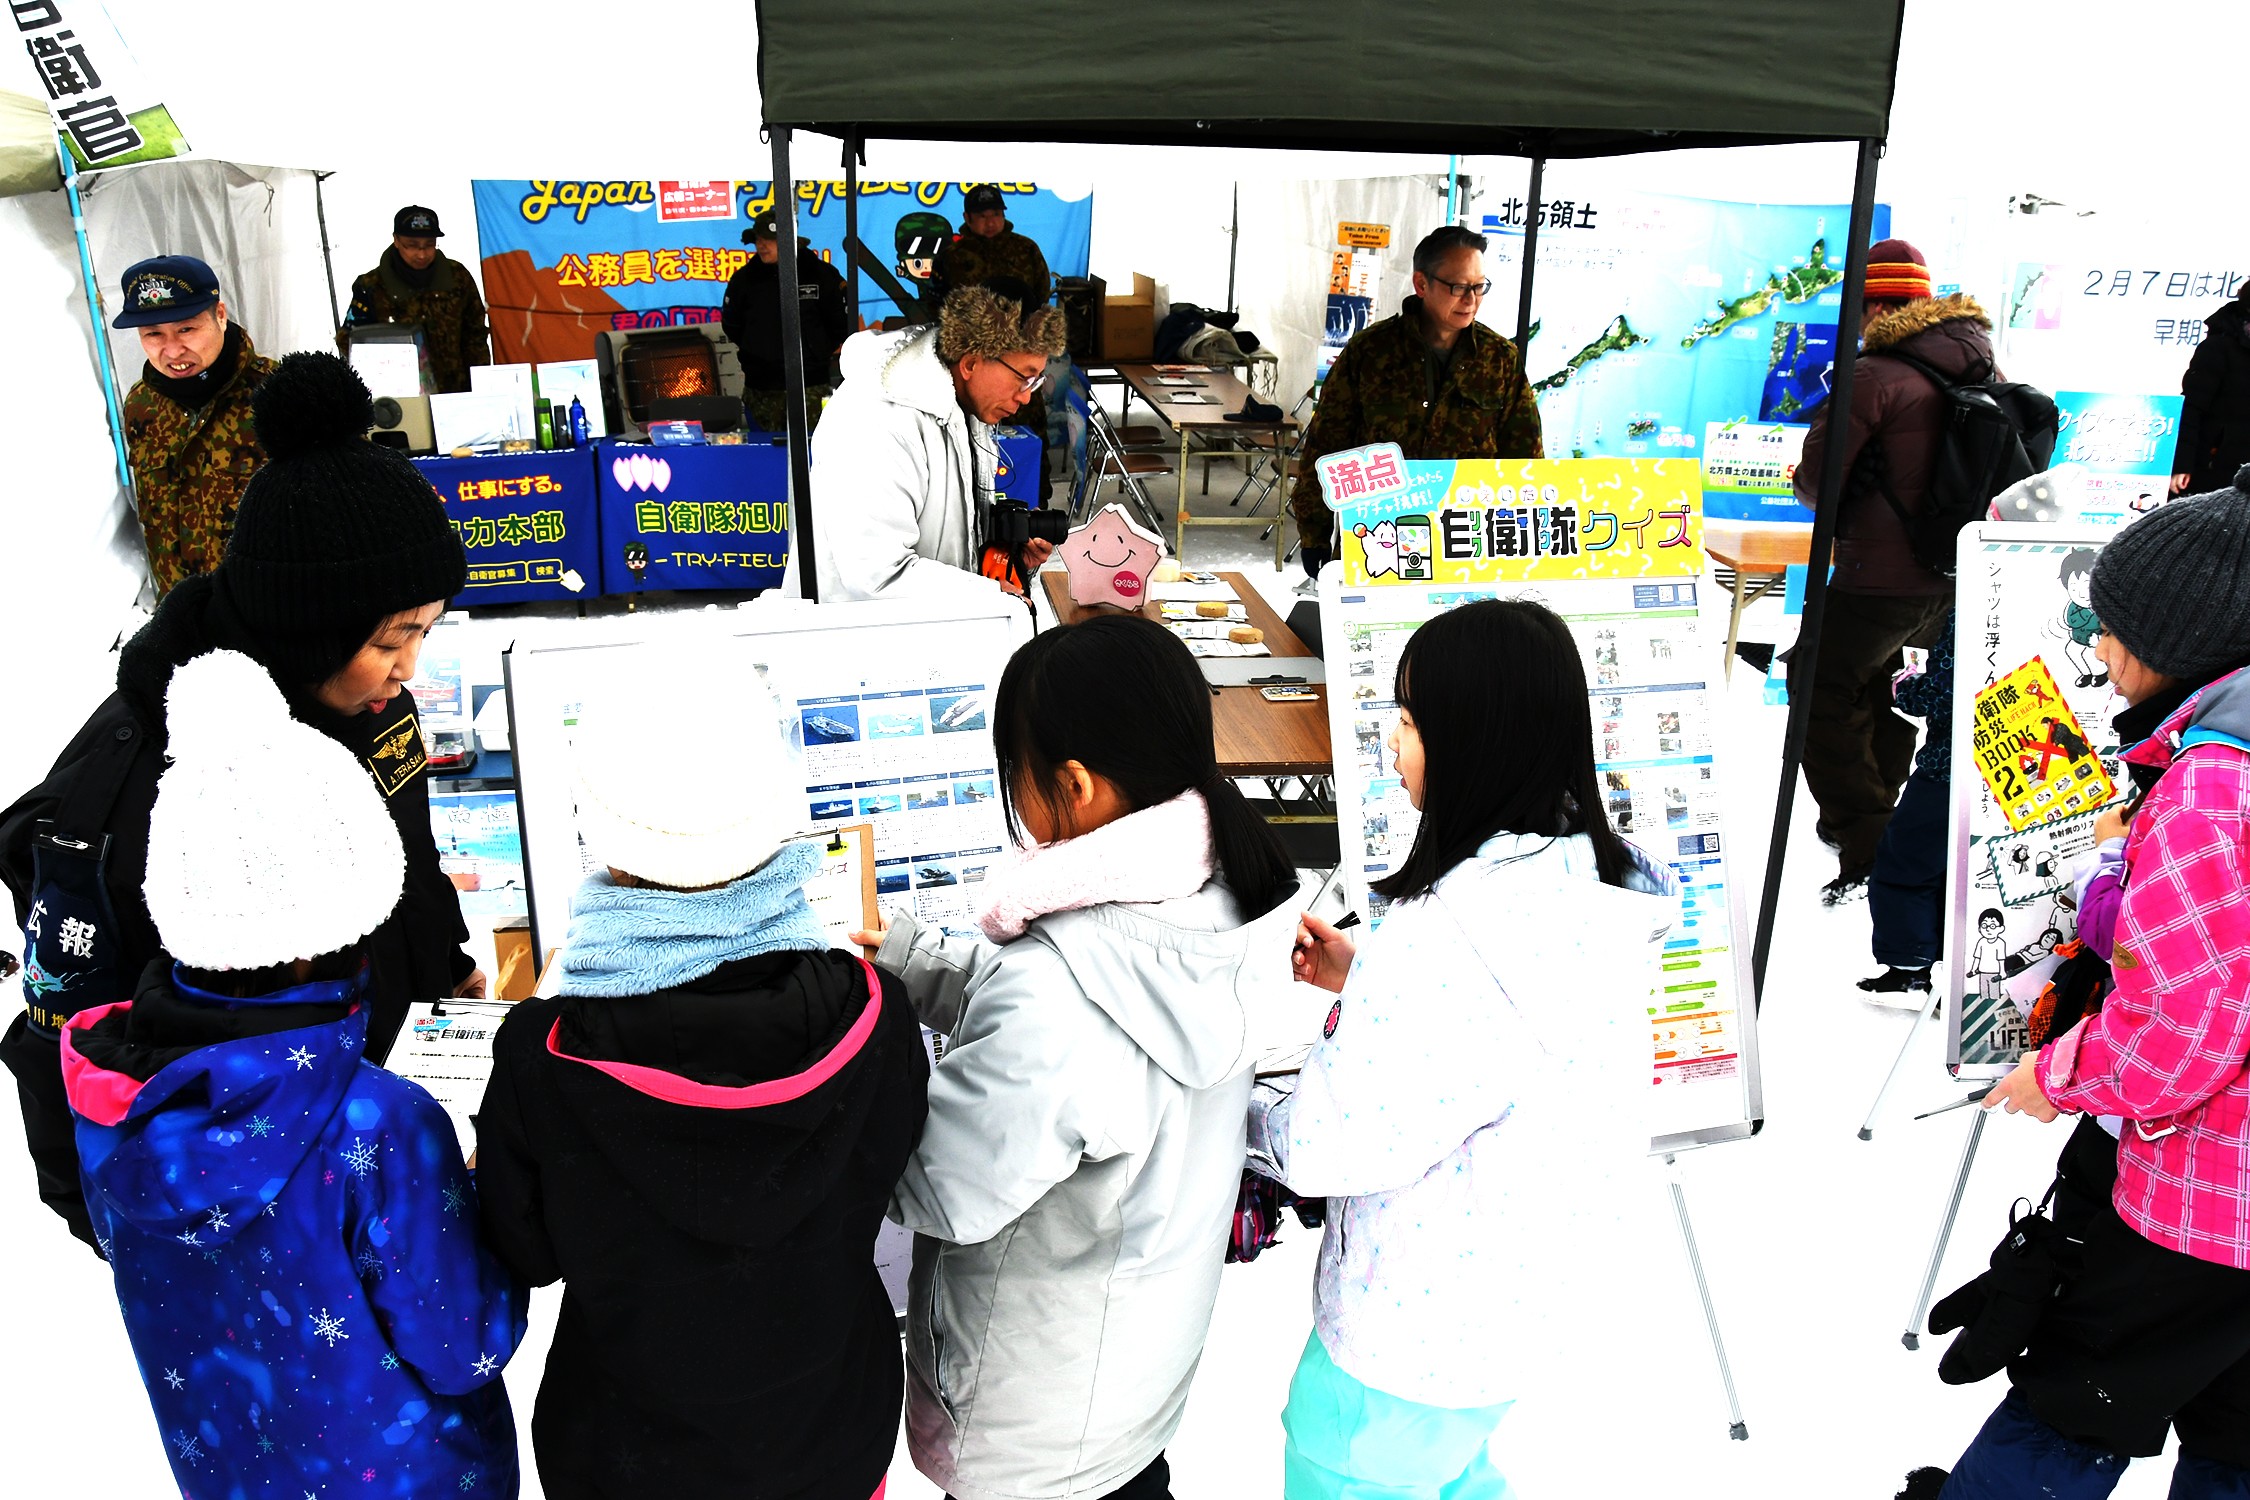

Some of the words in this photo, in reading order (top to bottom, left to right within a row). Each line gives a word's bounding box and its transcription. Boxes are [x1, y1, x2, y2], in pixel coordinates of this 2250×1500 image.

[1500, 197, 1598, 230] 北方領土
[2083, 269, 2250, 299] 2月7日は北
[2153, 319, 2208, 346] 早期
[1328, 453, 1401, 501] 満点
[449, 511, 567, 548] 力本部
[1974, 717, 2009, 751] 防災
[1981, 725, 2038, 770] BOOK
[1993, 765, 2025, 802] 2
[26, 1003, 67, 1030] 川地
